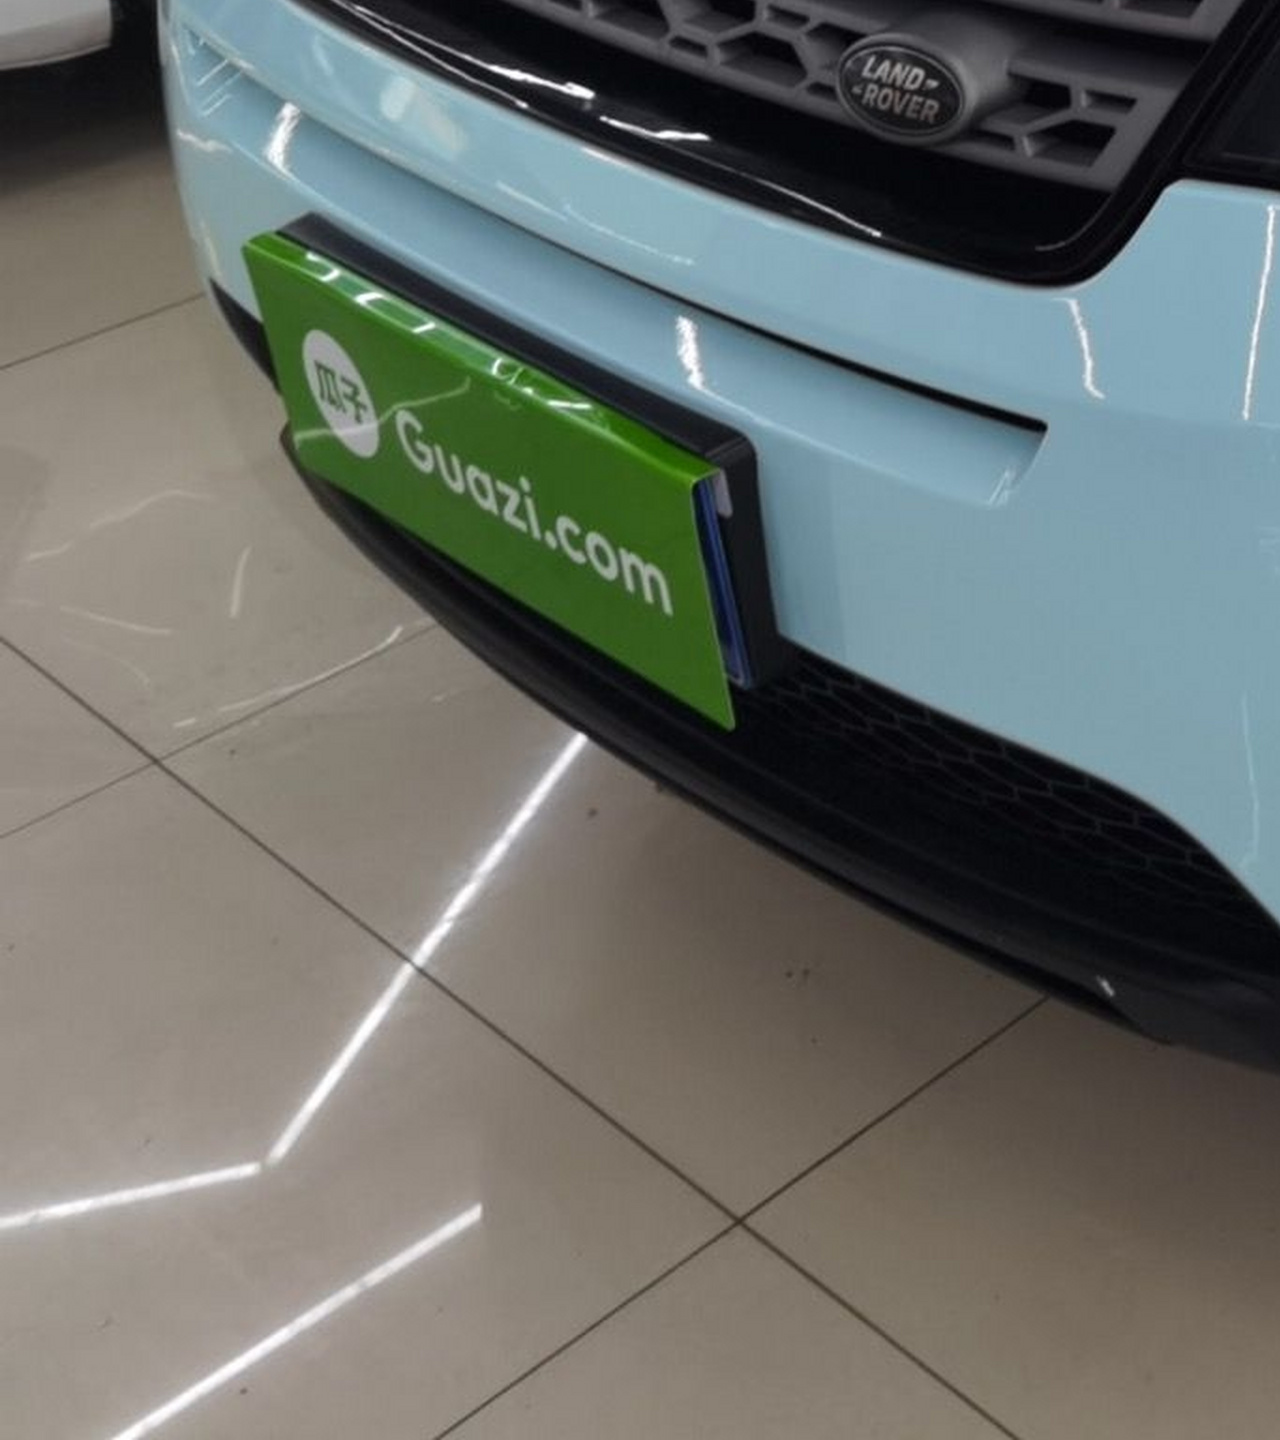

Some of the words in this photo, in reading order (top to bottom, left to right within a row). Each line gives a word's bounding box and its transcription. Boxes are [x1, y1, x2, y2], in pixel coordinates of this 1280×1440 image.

[862, 55, 926, 91] LAND
[861, 83, 940, 124] ROVER
[313, 359, 368, 425] 瓜子
[396, 409, 674, 617] Guazi.com
